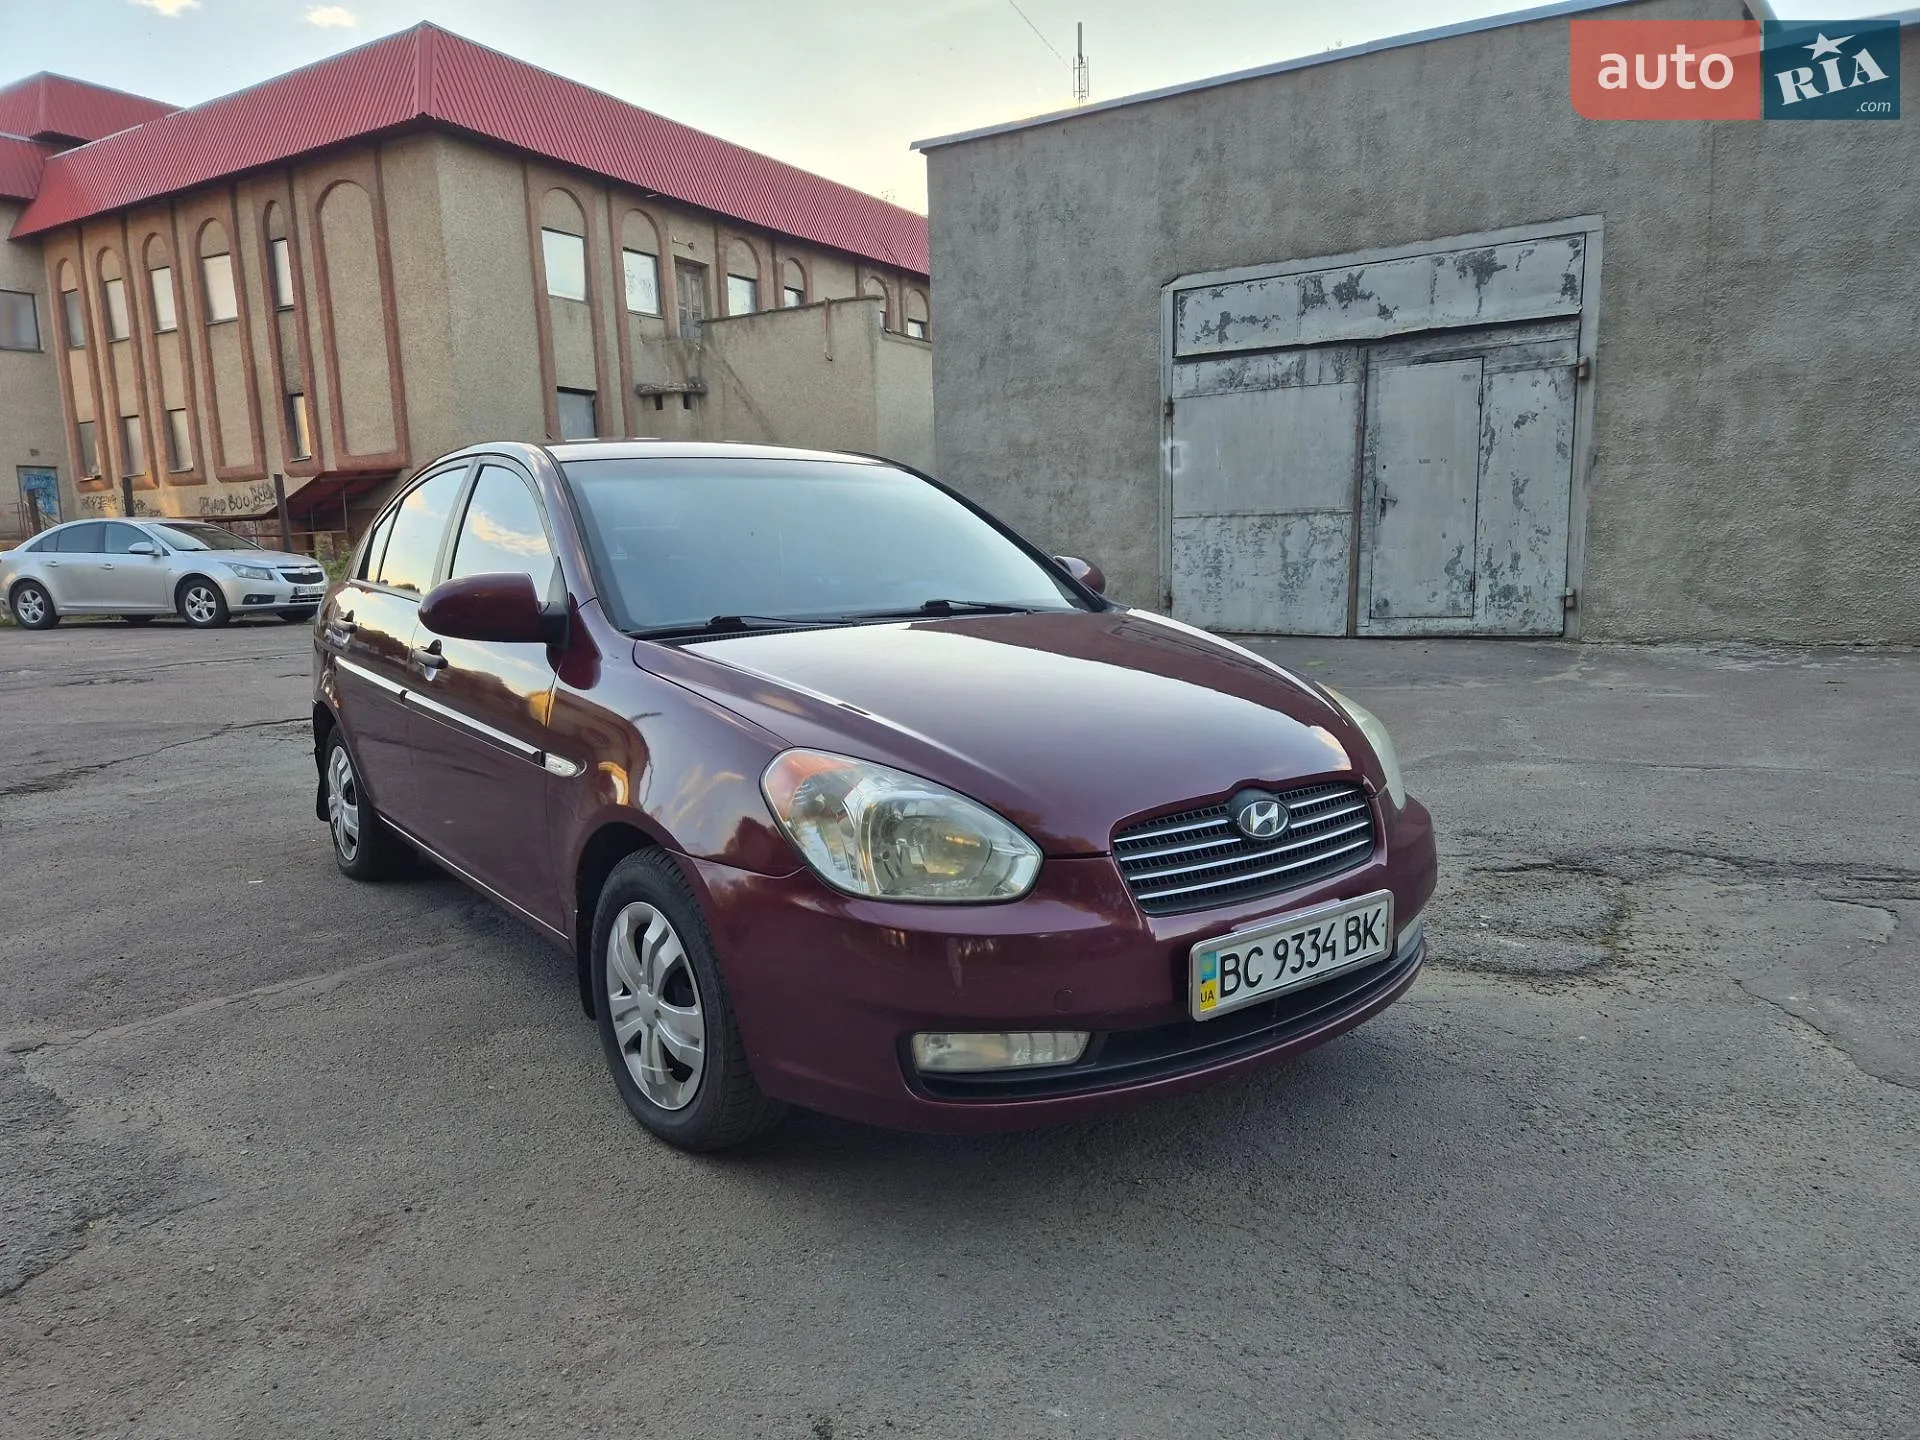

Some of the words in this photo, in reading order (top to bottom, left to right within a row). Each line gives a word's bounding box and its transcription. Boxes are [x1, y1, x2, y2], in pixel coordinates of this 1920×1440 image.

[1220, 947, 1263, 998] BC
[1273, 922, 1337, 980] 9334
[1344, 908, 1380, 956] BK
[1200, 992, 1215, 1003] UA
